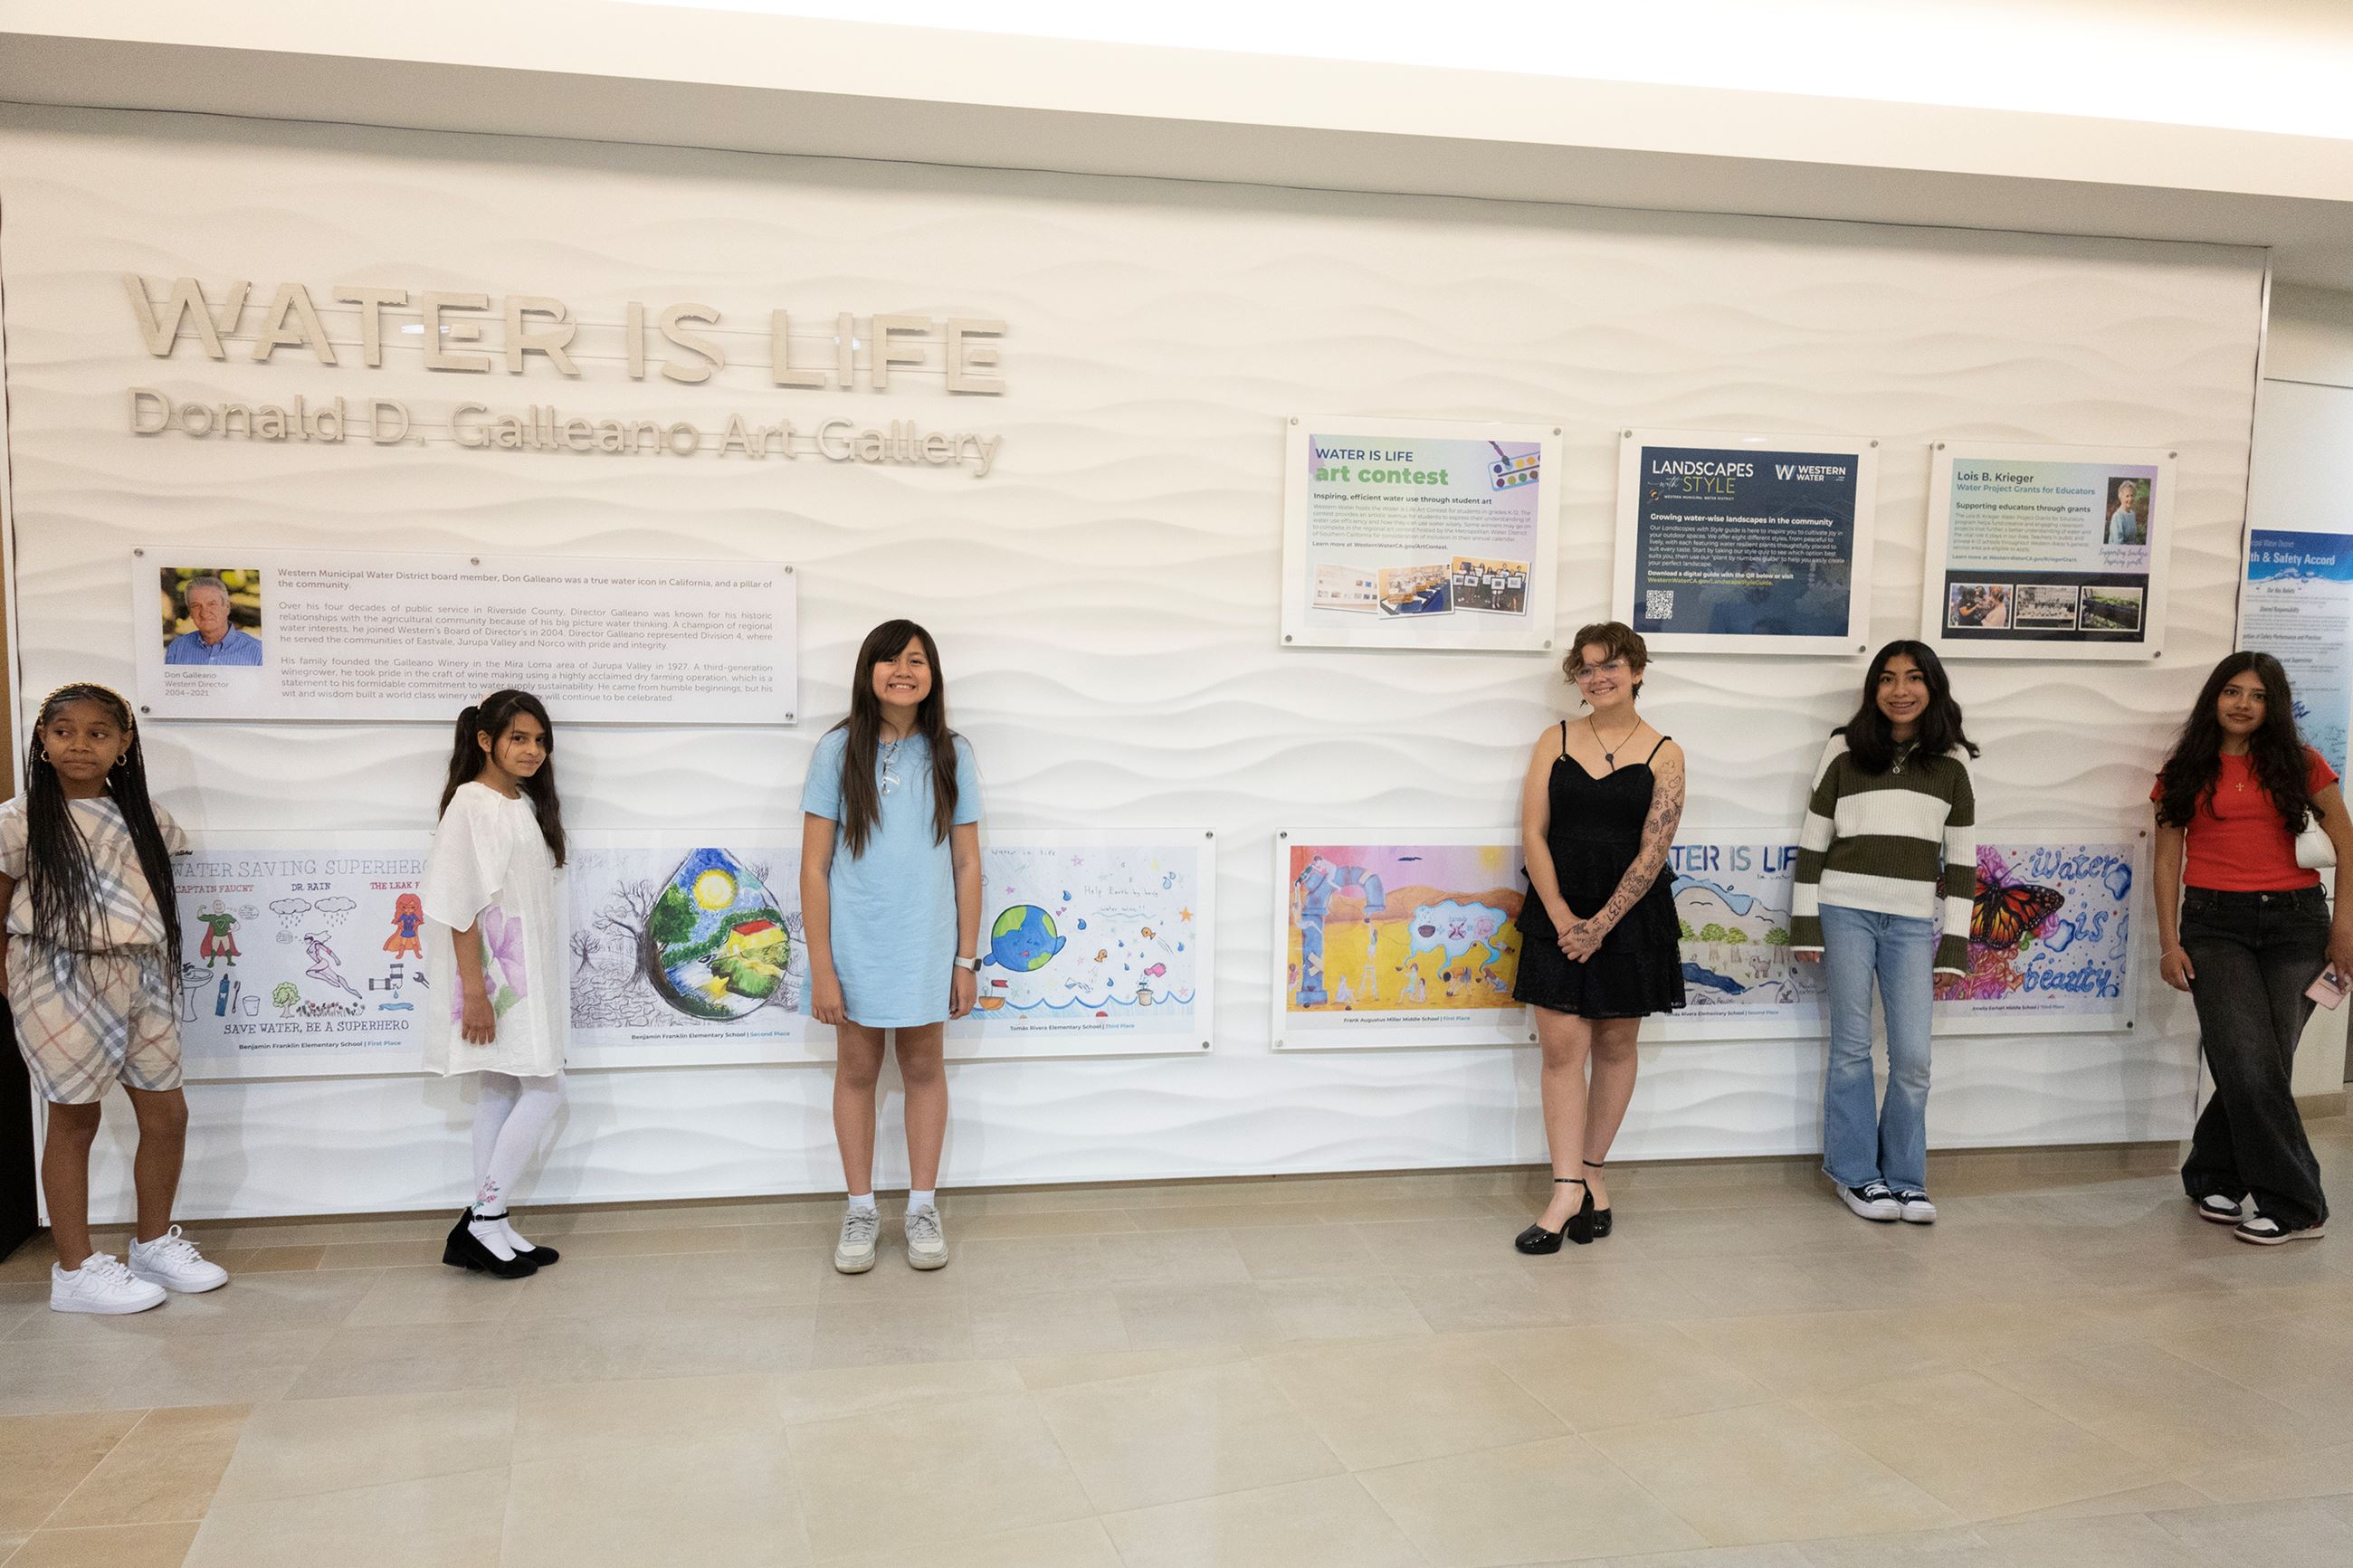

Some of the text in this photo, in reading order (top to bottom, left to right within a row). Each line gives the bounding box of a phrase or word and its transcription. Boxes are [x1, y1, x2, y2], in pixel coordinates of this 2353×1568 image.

[124, 274, 1006, 394] WATER IS LIFE
[127, 385, 1002, 477] Donald D. Galleano Art Gallery
[1315, 449, 1413, 462] WATER IS LIFE
[1315, 466, 1448, 486] art contest
[1653, 460, 1754, 478] LANDSCAPES
[1798, 465, 1846, 476] WESTERN
[1682, 477, 1736, 493] STYLE
[1958, 471, 2034, 485] Lois B. Krieger
[1957, 484, 1981, 492] Water
[1984, 485, 2011, 494] Project
[2014, 486, 2040, 494] Grants
[2055, 488, 2095, 496] Educators
[1314, 493, 1348, 502] Inspiring,
[1420, 496, 1450, 505] through
[1957, 501, 2091, 514] Supporting educators through grants
[1651, 514, 1681, 523] Growing
[1683, 514, 1724, 522] water-wise
[1726, 515, 1767, 525] landscapes
[1768, 516, 1776, 524] in
[1791, 517, 1833, 527] community
[2262, 552, 2271, 563] &
[2273, 552, 2301, 565] Safety
[2304, 554, 2335, 565] Accord
[277, 568, 316, 577] Western
[319, 570, 364, 581] Municipal
[366, 571, 393, 579] Water
[396, 572, 428, 580] District
[431, 573, 457, 581] board
[460, 573, 500, 584] member,
[502, 574, 520, 583] Don
[523, 575, 562, 584] Galleano
[590, 576, 608, 584] true
[611, 576, 635, 585] water
[637, 577, 656, 585] icon
[659, 578, 666, 586] in
[669, 578, 712, 589] California,
[715, 579, 730, 587] and
[740, 580, 761, 590] pillar
[763, 580, 771, 588] of
[278, 580, 350, 592] the community.
[279, 602, 300, 610] Over
[306, 603, 319, 611] his
[324, 603, 343, 611] four
[348, 603, 386, 612] decades
[391, 604, 400, 613] of
[405, 604, 433, 614] public
[438, 605, 469, 613] service
[474, 606, 481, 614] in
[487, 606, 526, 615] Riverside
[530, 607, 565, 617] County,
[570, 608, 605, 616] Director
[610, 609, 648, 617] Galleano
[674, 610, 703, 618] known
[708, 611, 719, 619] for
[725, 611, 737, 619] his
[741, 612, 771, 620] historic
[1667, 845, 1798, 872] TER IS LIF
[2030, 847, 2119, 880] Water
[238, 860, 316, 878] SAVING
[325, 859, 426, 876] SUPERHER
[176, 885, 217, 894] CAPTAIN
[291, 883, 305, 891] DR.
[307, 882, 331, 891] RAIN
[2075, 902, 2109, 942] is
[2023, 955, 2119, 998] beauty
[224, 1021, 409, 1035] SAVE WATER, BE A SUPERHERO
[1048, 1023, 1081, 1031] Elementary
[689, 1031, 724, 1040] Elementary
[300, 1041, 338, 1050] Elementary
